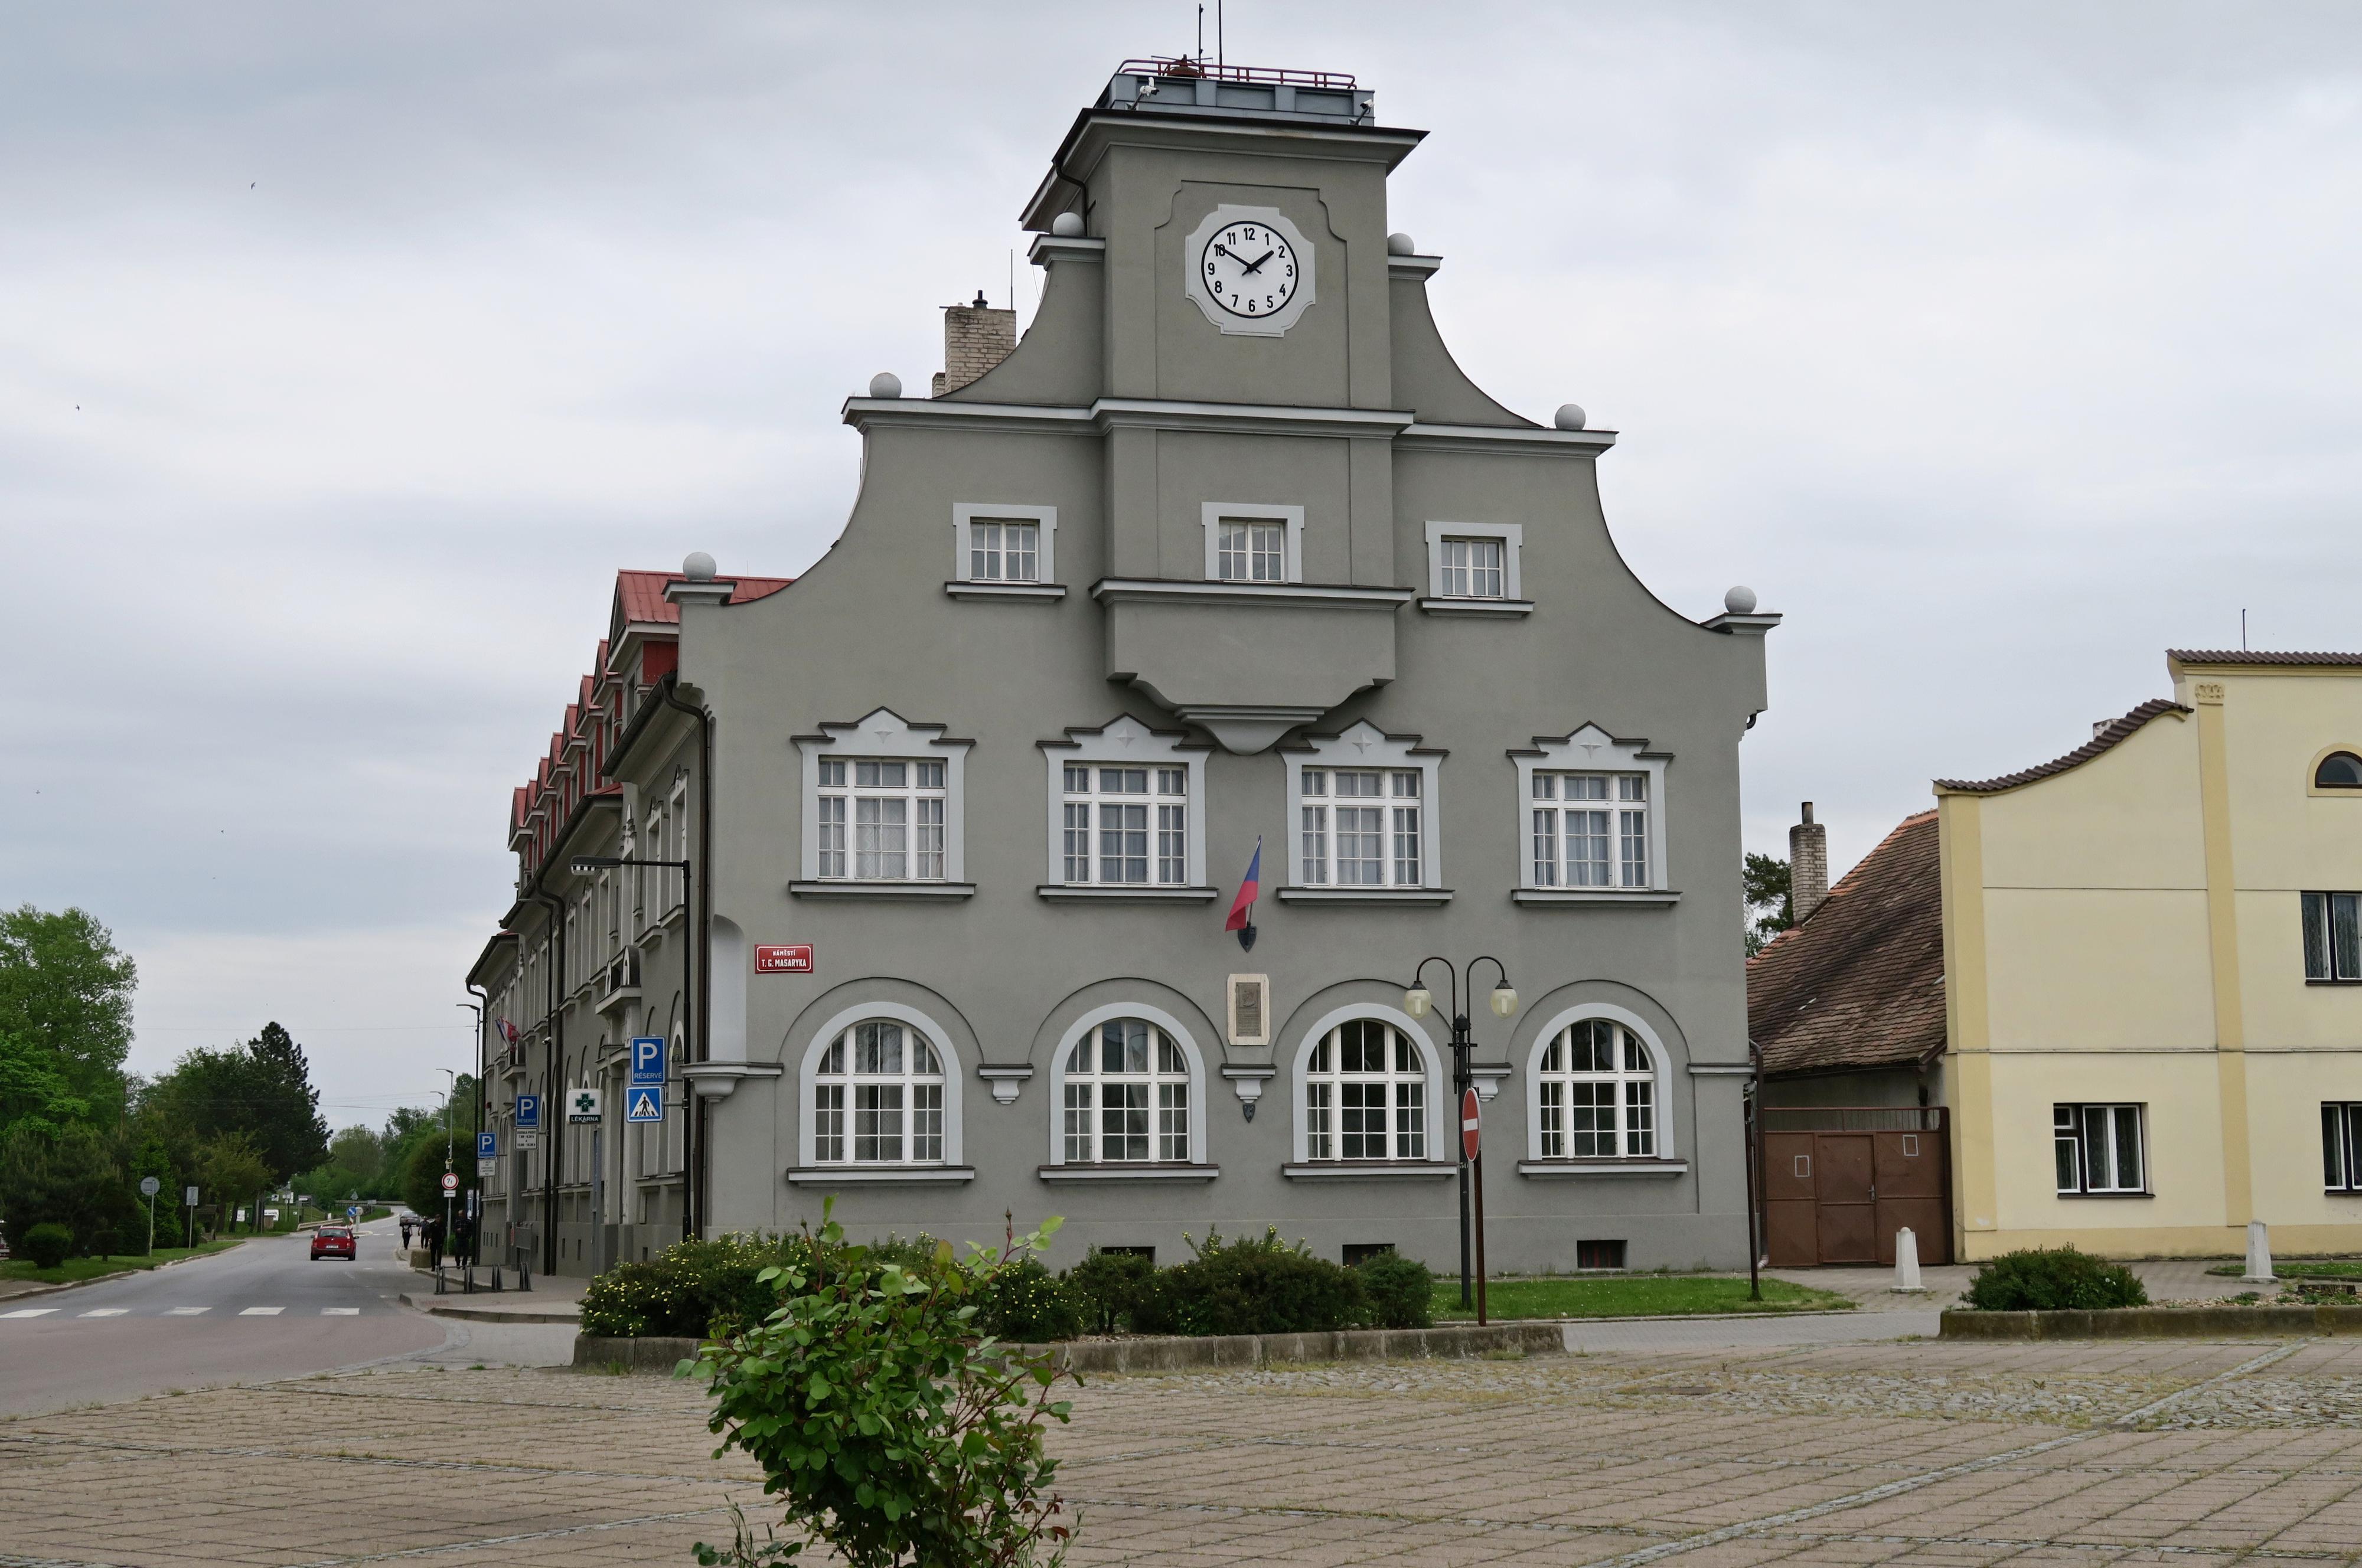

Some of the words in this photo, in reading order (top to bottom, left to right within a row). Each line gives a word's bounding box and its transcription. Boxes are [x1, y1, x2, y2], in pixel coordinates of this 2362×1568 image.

[1227, 233, 1236, 245] 11
[1244, 228, 1255, 240] 12
[1265, 233, 1270, 245] 1
[1214, 244, 1225, 257] 10
[1278, 246, 1286, 258] 2
[1208, 263, 1215, 275] 9
[1286, 264, 1293, 277] 3
[1215, 280, 1222, 293] 8
[1279, 283, 1286, 296] 4
[1232, 294, 1239, 307] 7
[1248, 299, 1255, 312] 6
[1267, 295, 1273, 308] 5
[775, 959, 807, 967] MASARYKA
[639, 1043, 657, 1069] P
[521, 1099, 534, 1116] P
[482, 1136, 492, 1150] P
